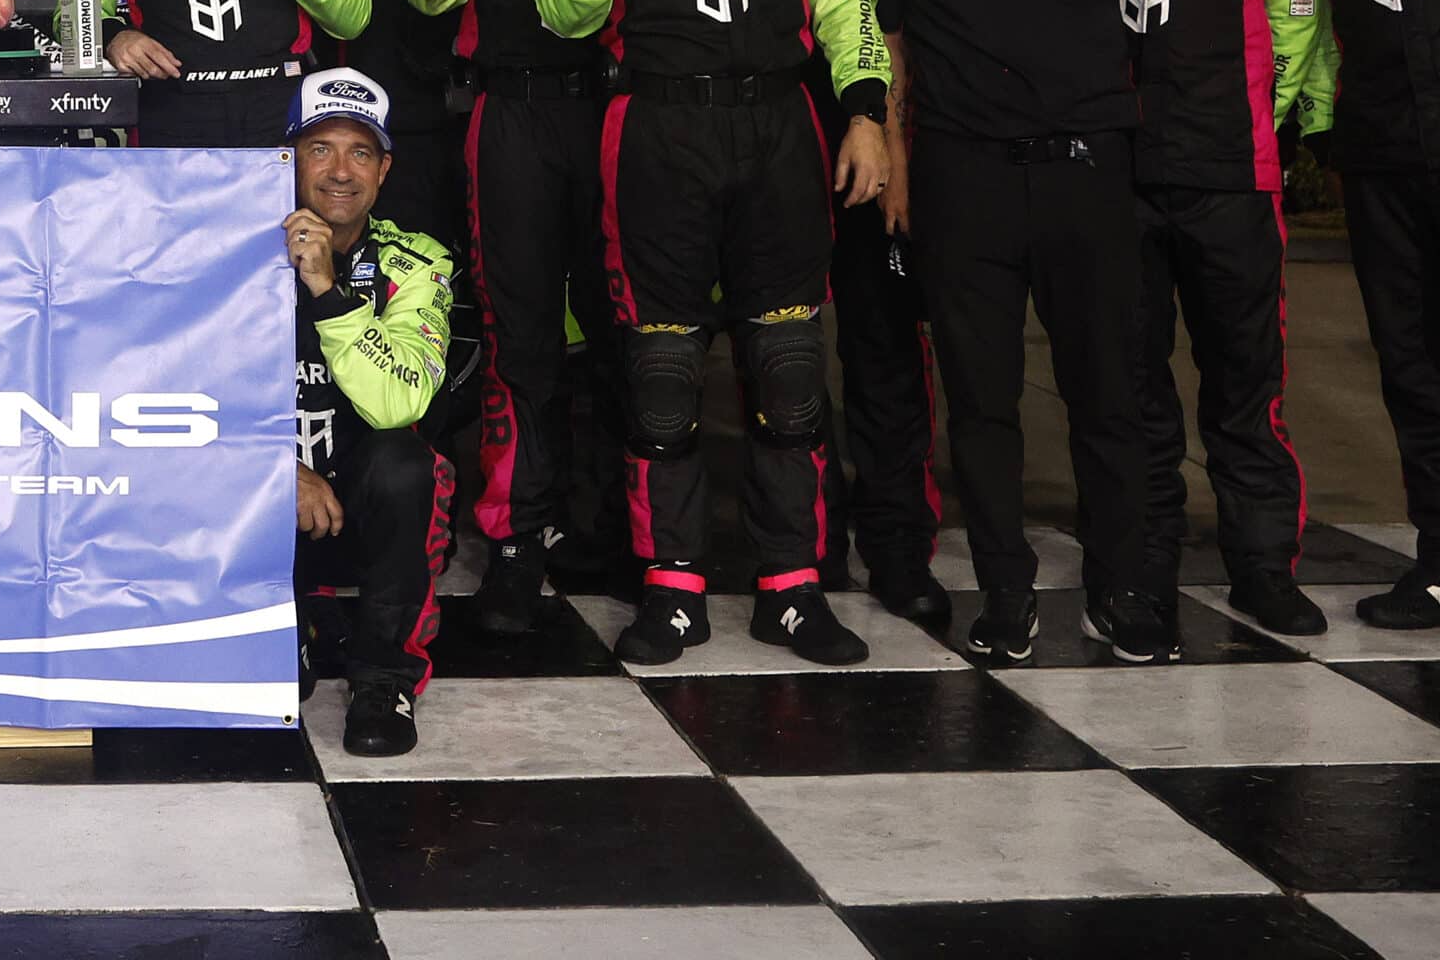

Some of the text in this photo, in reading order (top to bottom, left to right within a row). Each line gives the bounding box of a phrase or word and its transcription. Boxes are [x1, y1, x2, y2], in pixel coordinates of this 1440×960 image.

[186, 67, 278, 81] RYAN BLANEY
[329, 82, 368, 101] Ford
[50, 91, 112, 113] xfinity
[314, 102, 379, 122] RACING
[388, 256, 413, 271] OMP
